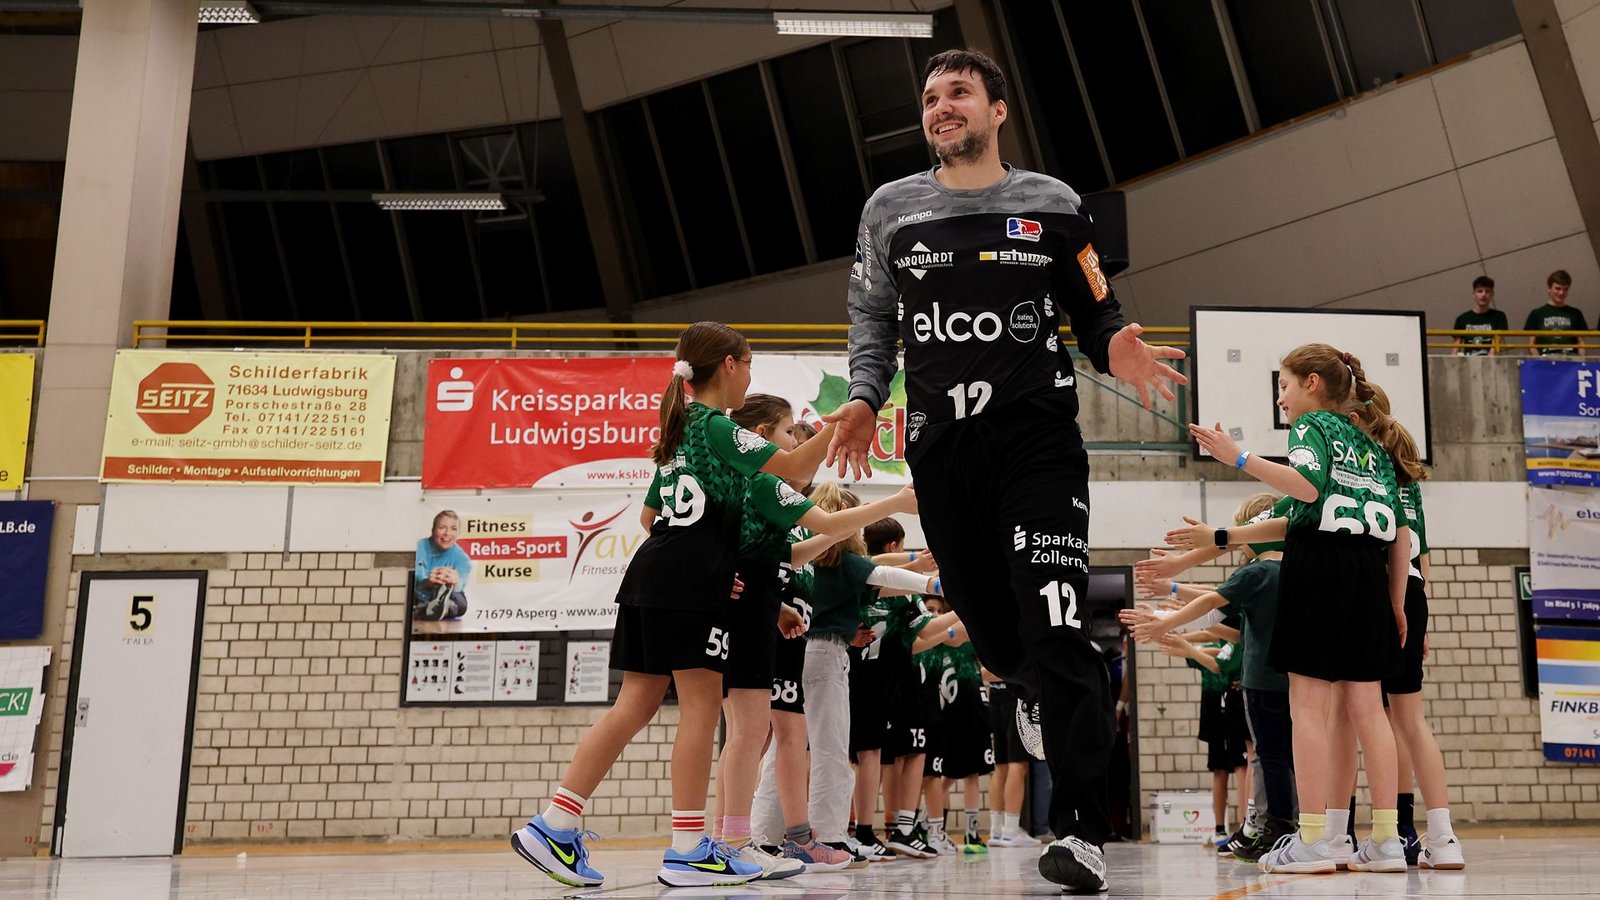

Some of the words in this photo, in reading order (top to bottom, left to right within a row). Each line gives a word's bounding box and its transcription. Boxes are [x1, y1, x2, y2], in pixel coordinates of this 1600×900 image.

[897, 210, 933, 224] Kempa
[913, 302, 1003, 342] elco
[1011, 321, 1037, 329] solutions
[228, 365, 369, 381] Schilderfabrik
[141, 389, 210, 409] SEITZ
[226, 384, 269, 397] 71634
[273, 385, 368, 400] Ludwigsburg
[947, 380, 993, 420] 12
[225, 400, 342, 411] Porschestraße
[349, 401, 367, 412] 28
[492, 388, 693, 416] Kreissparkas
[224, 412, 251, 423] Tel.
[222, 425, 249, 435] Fax
[131, 437, 175, 448] e-mail:
[1332, 441, 1377, 475] SAVE
[127, 463, 174, 476] Schilder
[183, 465, 231, 478] Montage
[240, 466, 361, 479] Aufstellvorrichtungen
[1072, 496, 1089, 516] Kem
[467, 519, 527, 533] Fitness
[470, 541, 562, 558] Reha-Sport
[594, 532, 650, 560] av
[1031, 532, 1089, 557] Sparkas
[484, 564, 533, 578] Kurse
[581, 564, 618, 576] Fitness
[1039, 580, 1082, 629] 12
[129, 595, 154, 632] 5
[476, 609, 513, 619] 71679
[516, 608, 557, 621] Asperg
[705, 626, 729, 660] 59
[1564, 747, 1596, 759] 07141
